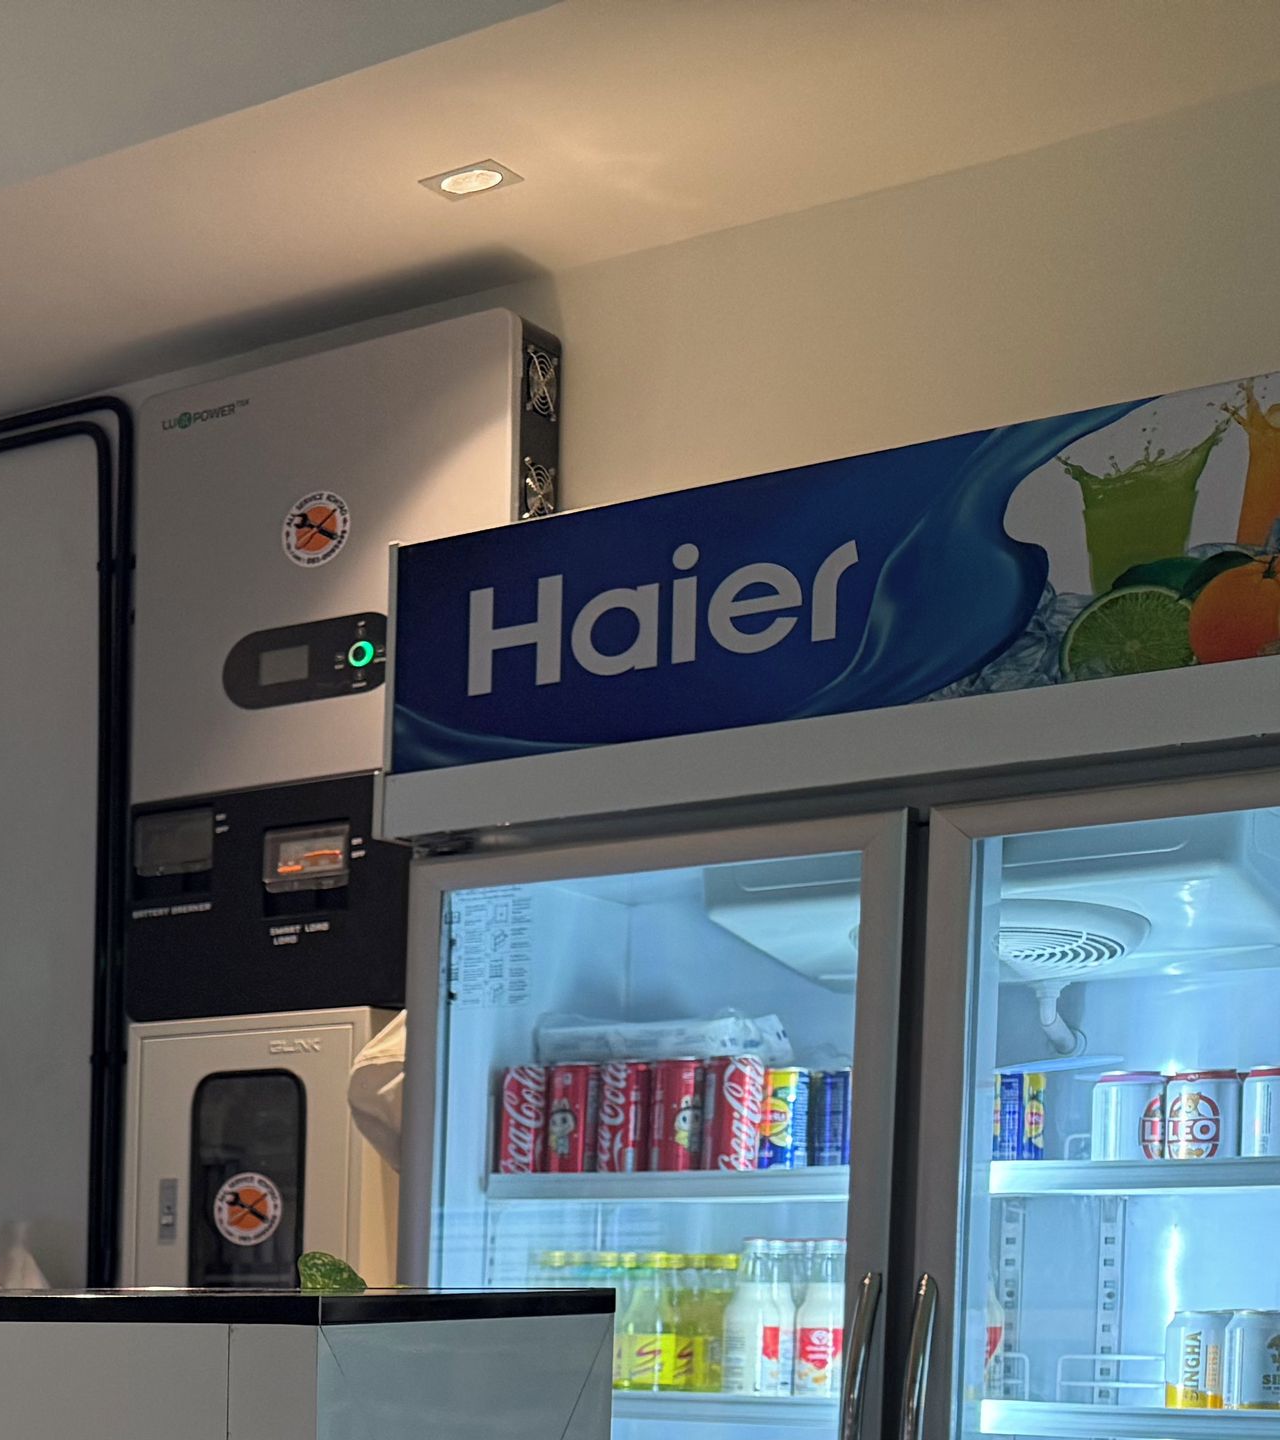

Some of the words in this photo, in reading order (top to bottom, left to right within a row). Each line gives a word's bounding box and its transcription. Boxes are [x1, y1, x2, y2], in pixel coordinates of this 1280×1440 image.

[466, 539, 859, 698] Haier
[1168, 1120, 1217, 1141] LEO
[1183, 1330, 1203, 1401] SINGHA
